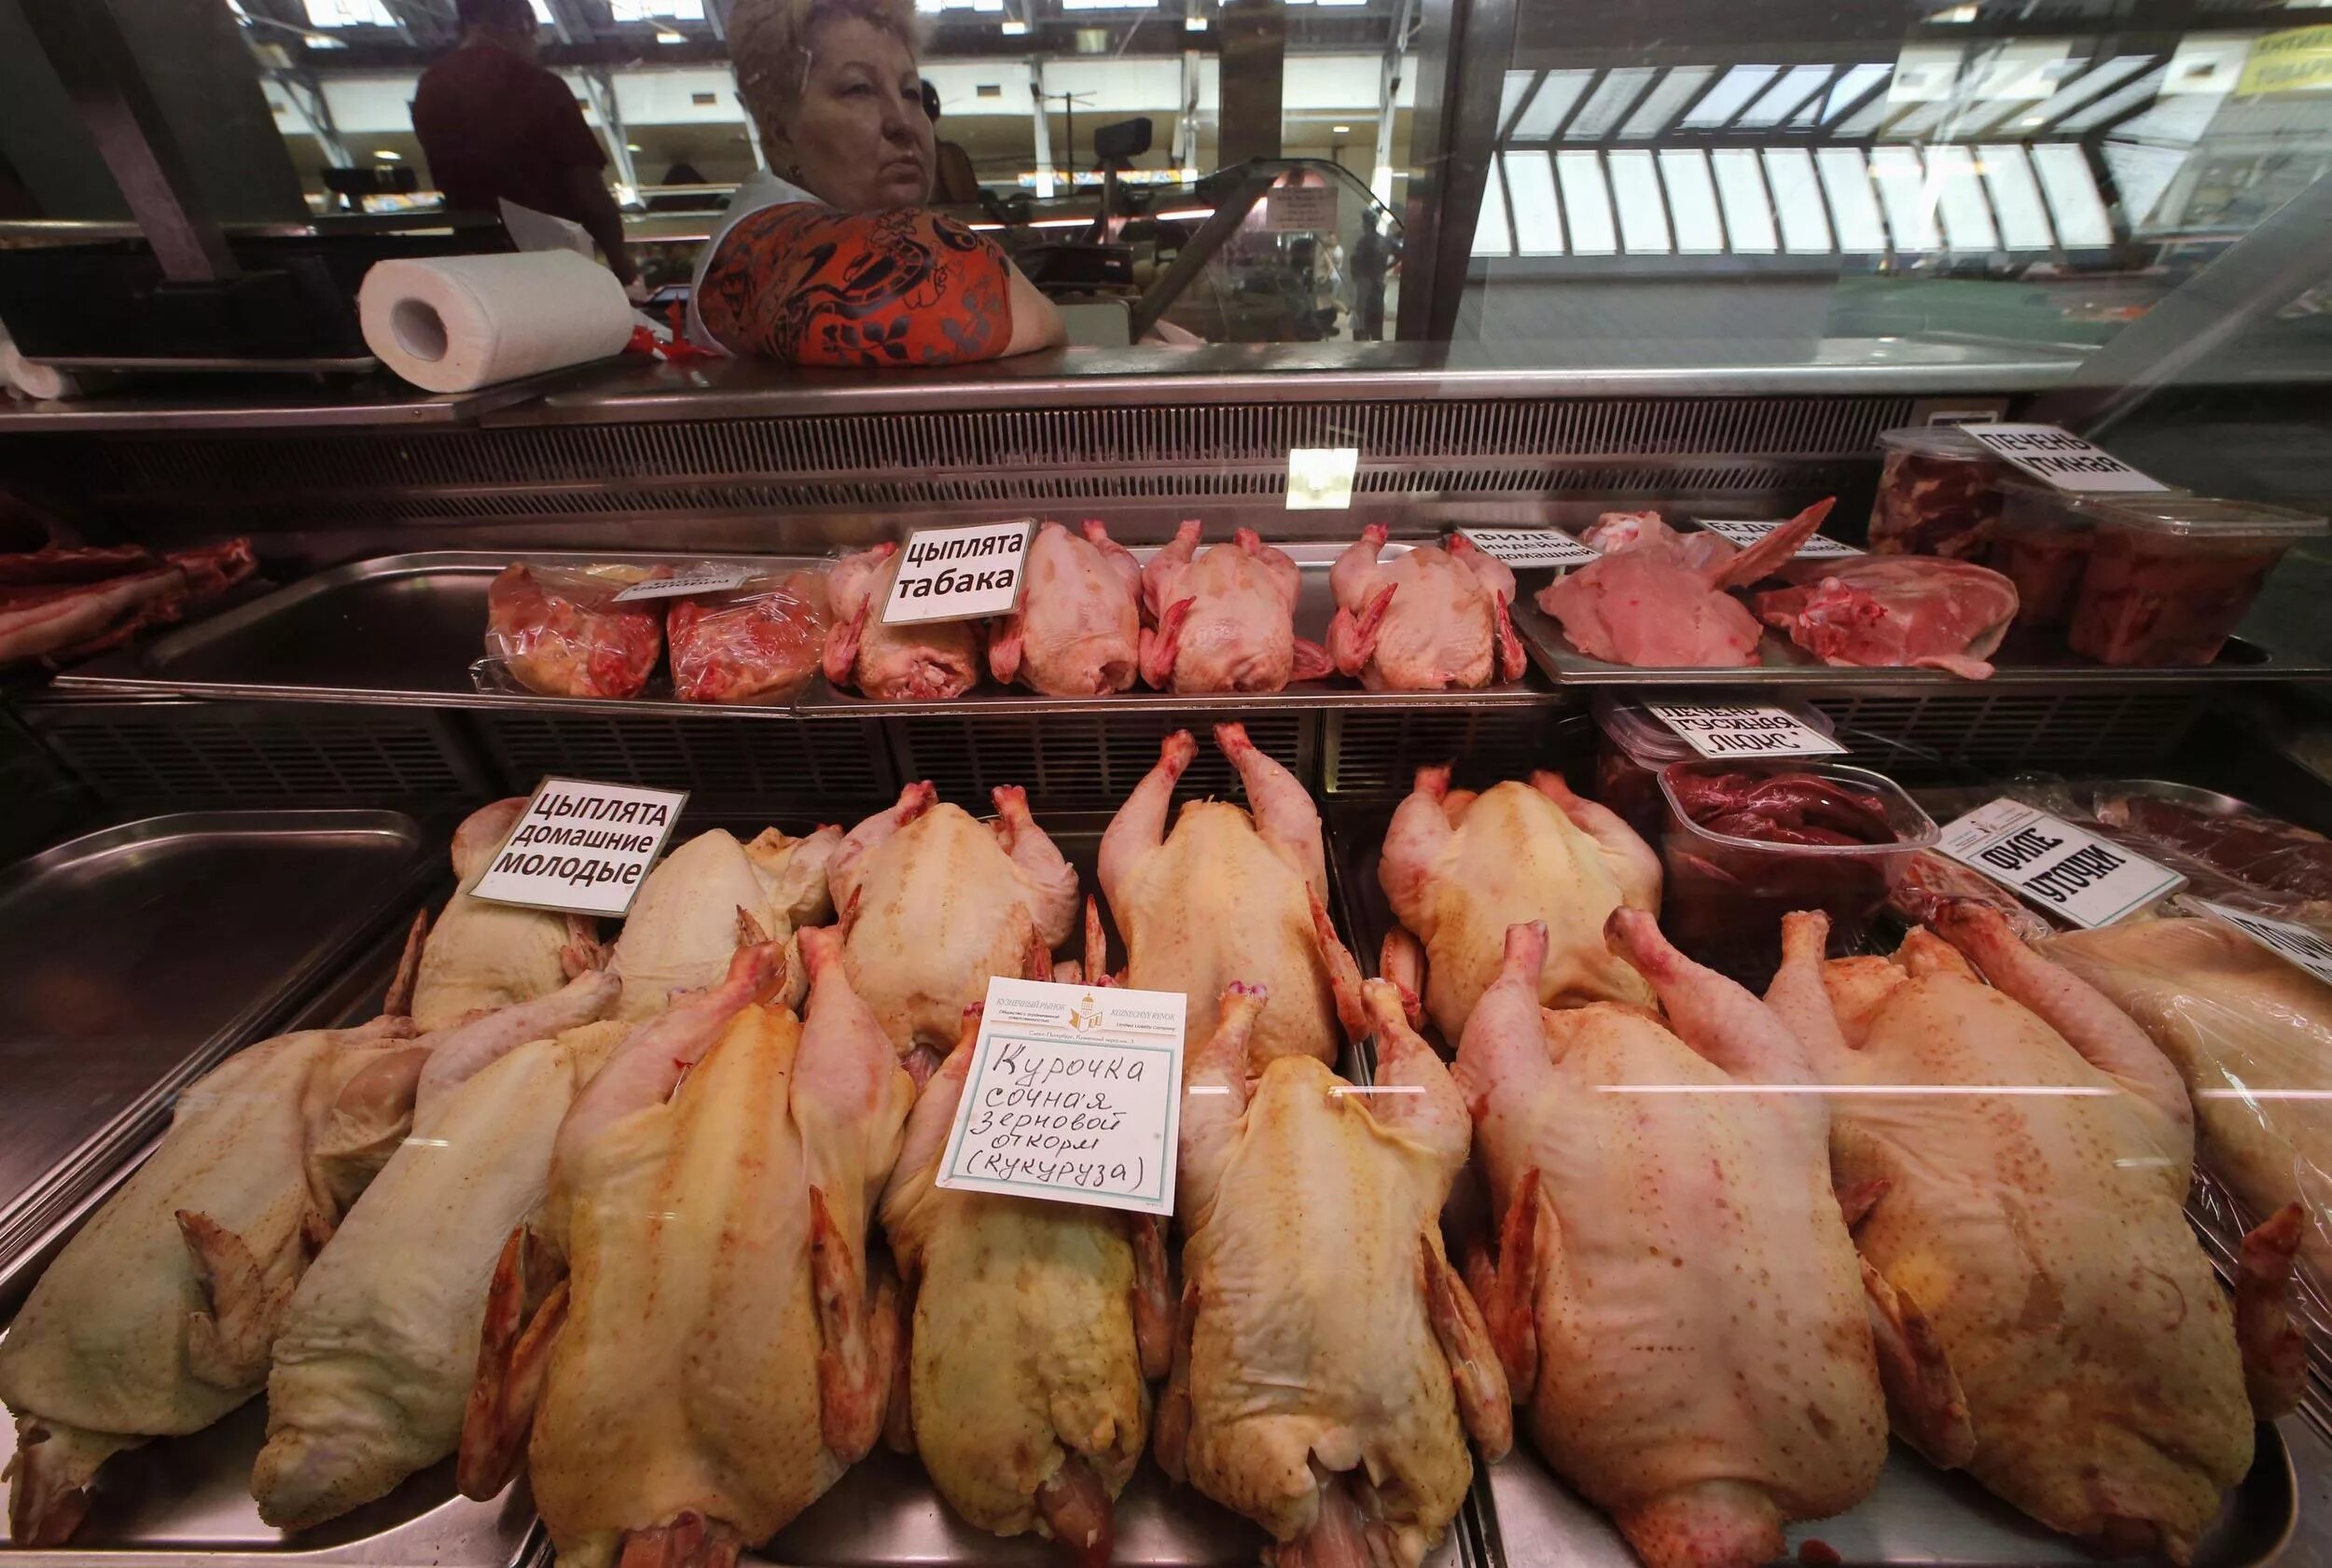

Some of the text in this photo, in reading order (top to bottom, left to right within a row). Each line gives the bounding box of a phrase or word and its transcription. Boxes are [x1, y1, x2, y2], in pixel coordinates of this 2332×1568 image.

[1978, 433, 2091, 451] ПЕЧЕНЬ
[1473, 532, 1559, 542] ФИЛЕ
[1707, 521, 1776, 534] БЕДР
[1480, 541, 1580, 551] индейки
[1494, 548, 1596, 561] домашней
[898, 567, 1015, 599] табака
[1671, 716, 1802, 730] ГУСИНАЯ
[533, 793, 669, 827] ЦЫПЛЯТА
[510, 824, 654, 853] домашние
[1980, 826, 2064, 871] ФИЛЕ
[493, 852, 643, 887] молодые
[995, 998, 1067, 1011] КУЗНЕЧНЫЙ РЫНОК
[992, 1042, 1145, 1087] Курочка
[985, 1088, 1113, 1111] сочная
[970, 1110, 1127, 1135] зерновой
[991, 1132, 1100, 1158] откорм
[966, 1149, 1145, 1193] (кукуруза)
